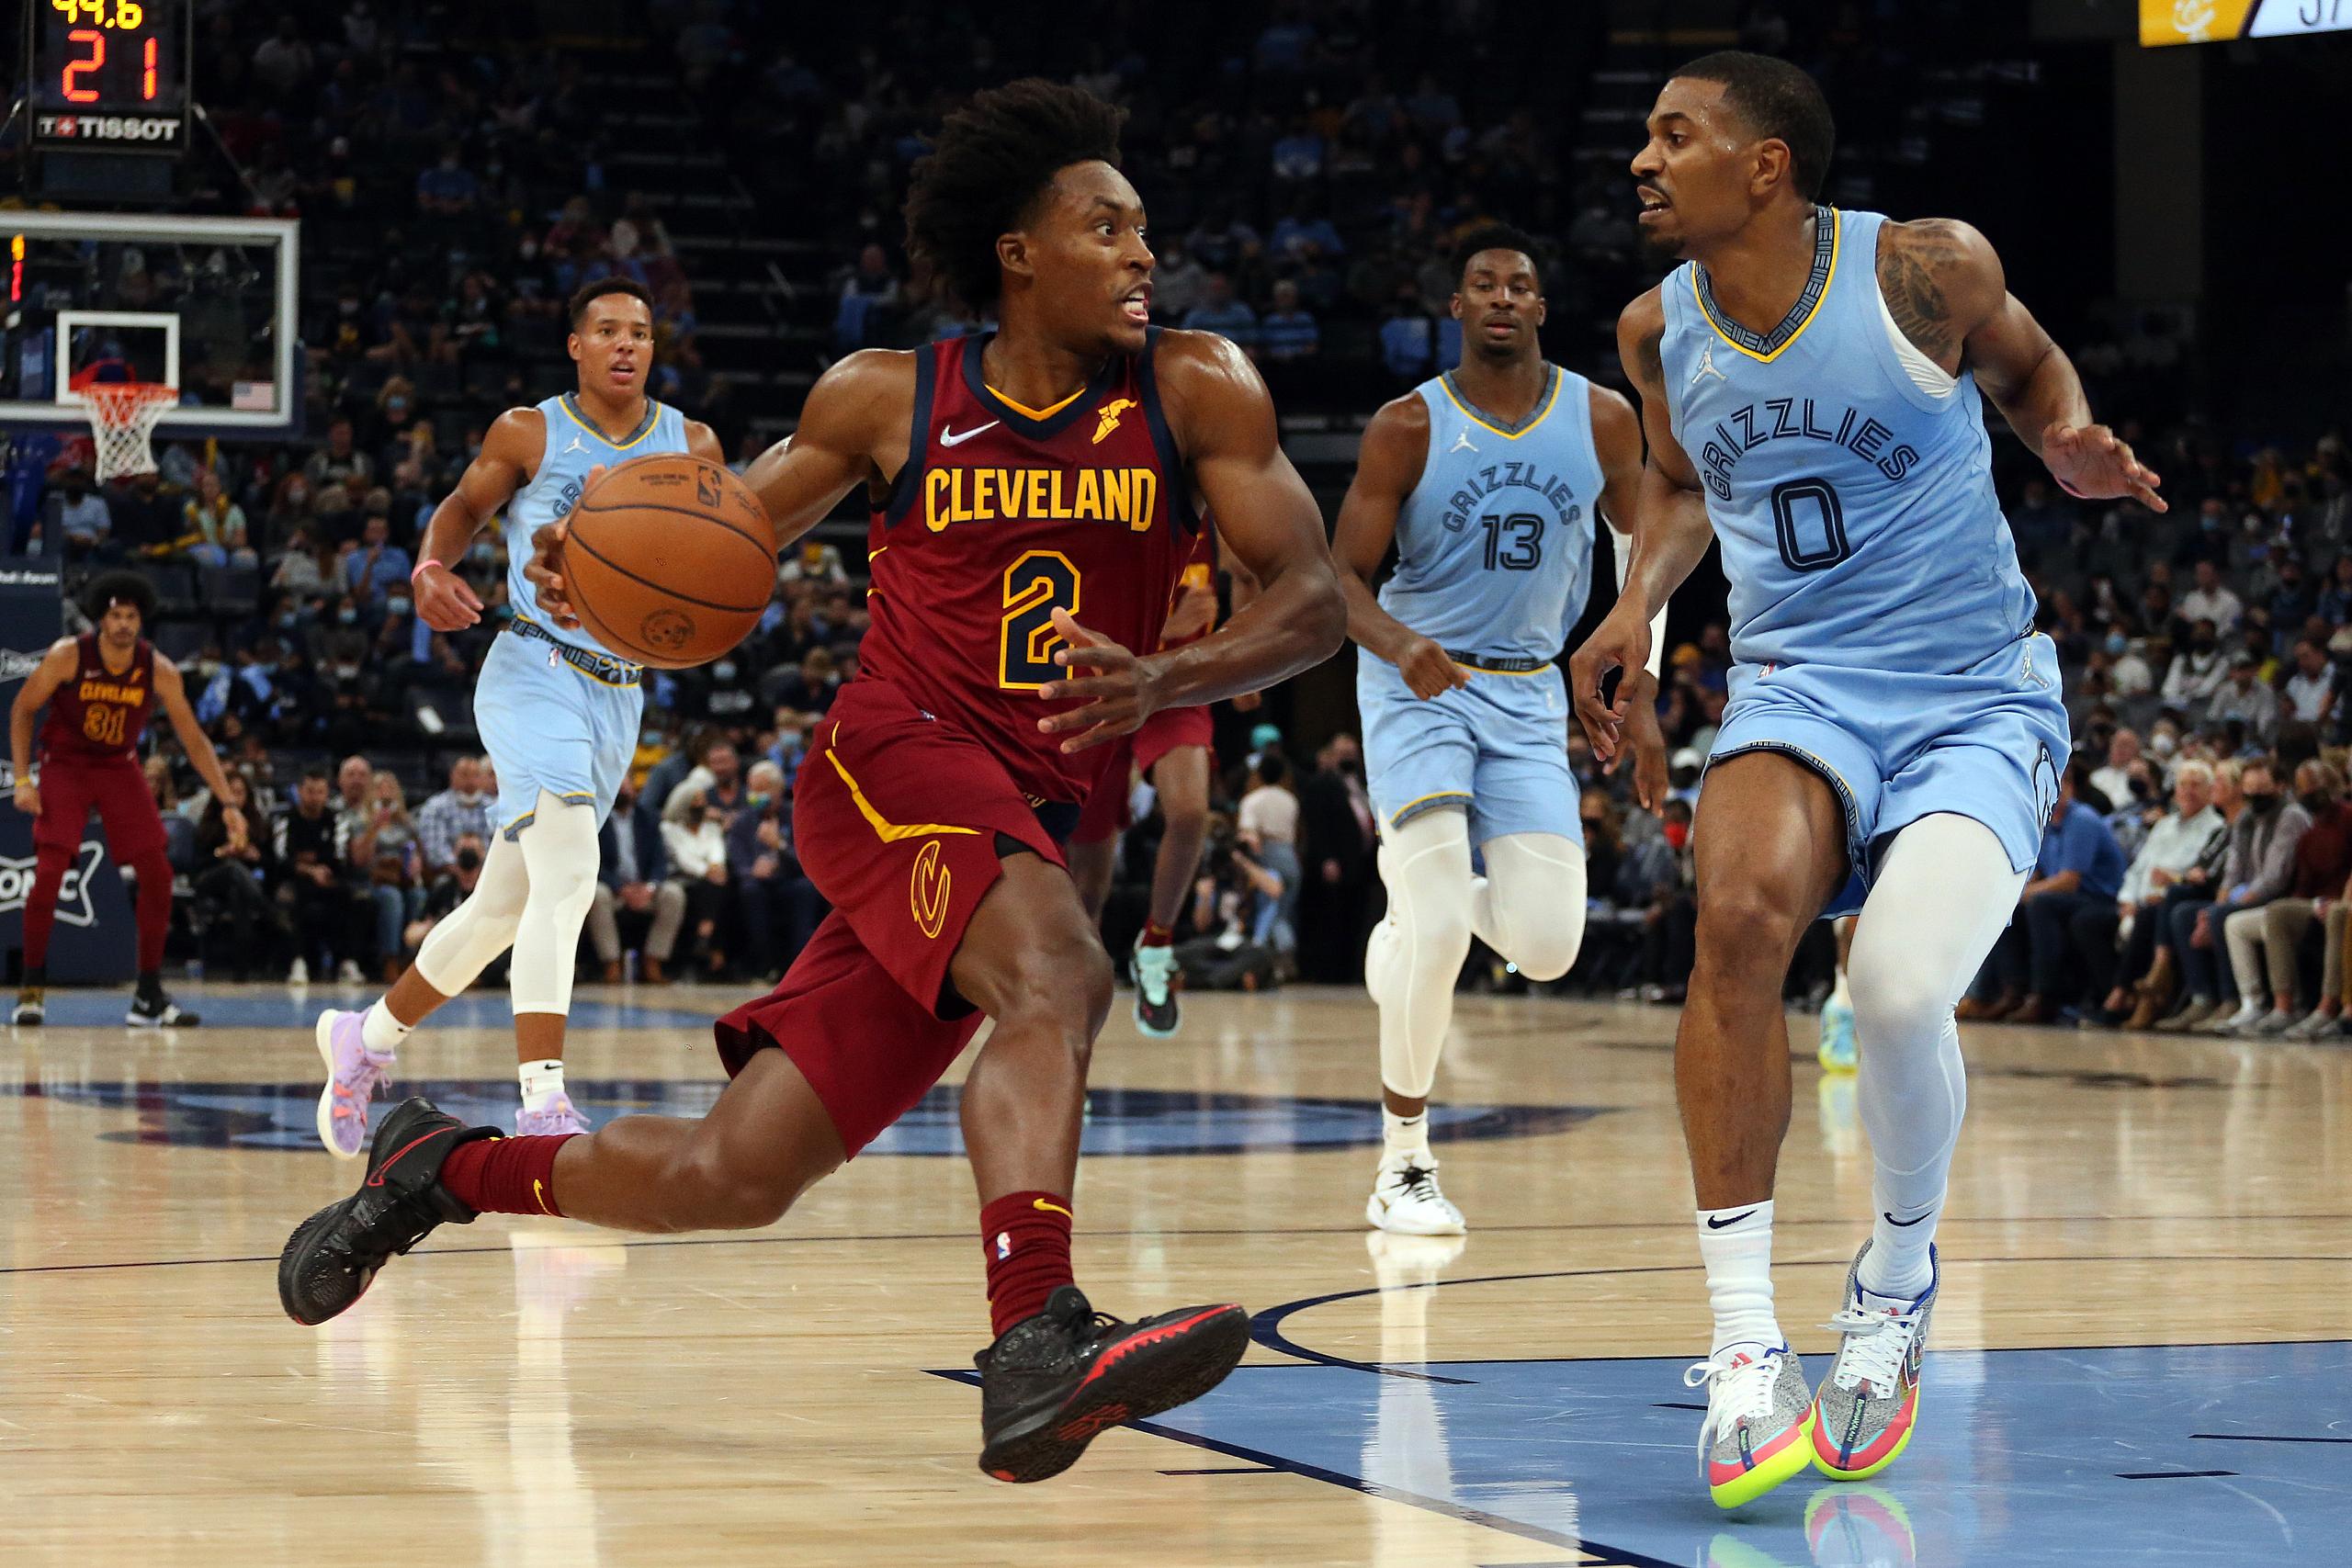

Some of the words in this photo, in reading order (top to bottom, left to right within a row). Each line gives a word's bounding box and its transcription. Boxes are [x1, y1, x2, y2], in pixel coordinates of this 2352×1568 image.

[62, 29, 157, 102] 21
[77, 116, 181, 141] TISSOT
[1702, 397, 1921, 502] GRIZZLIES
[925, 468, 1157, 533] CLEVELAND
[1442, 462, 1581, 533] GRIZZLIES
[1770, 477, 1851, 573] 0
[1482, 513, 1545, 571] 13
[1000, 549, 1081, 692] 2
[83, 702, 127, 746] 31
